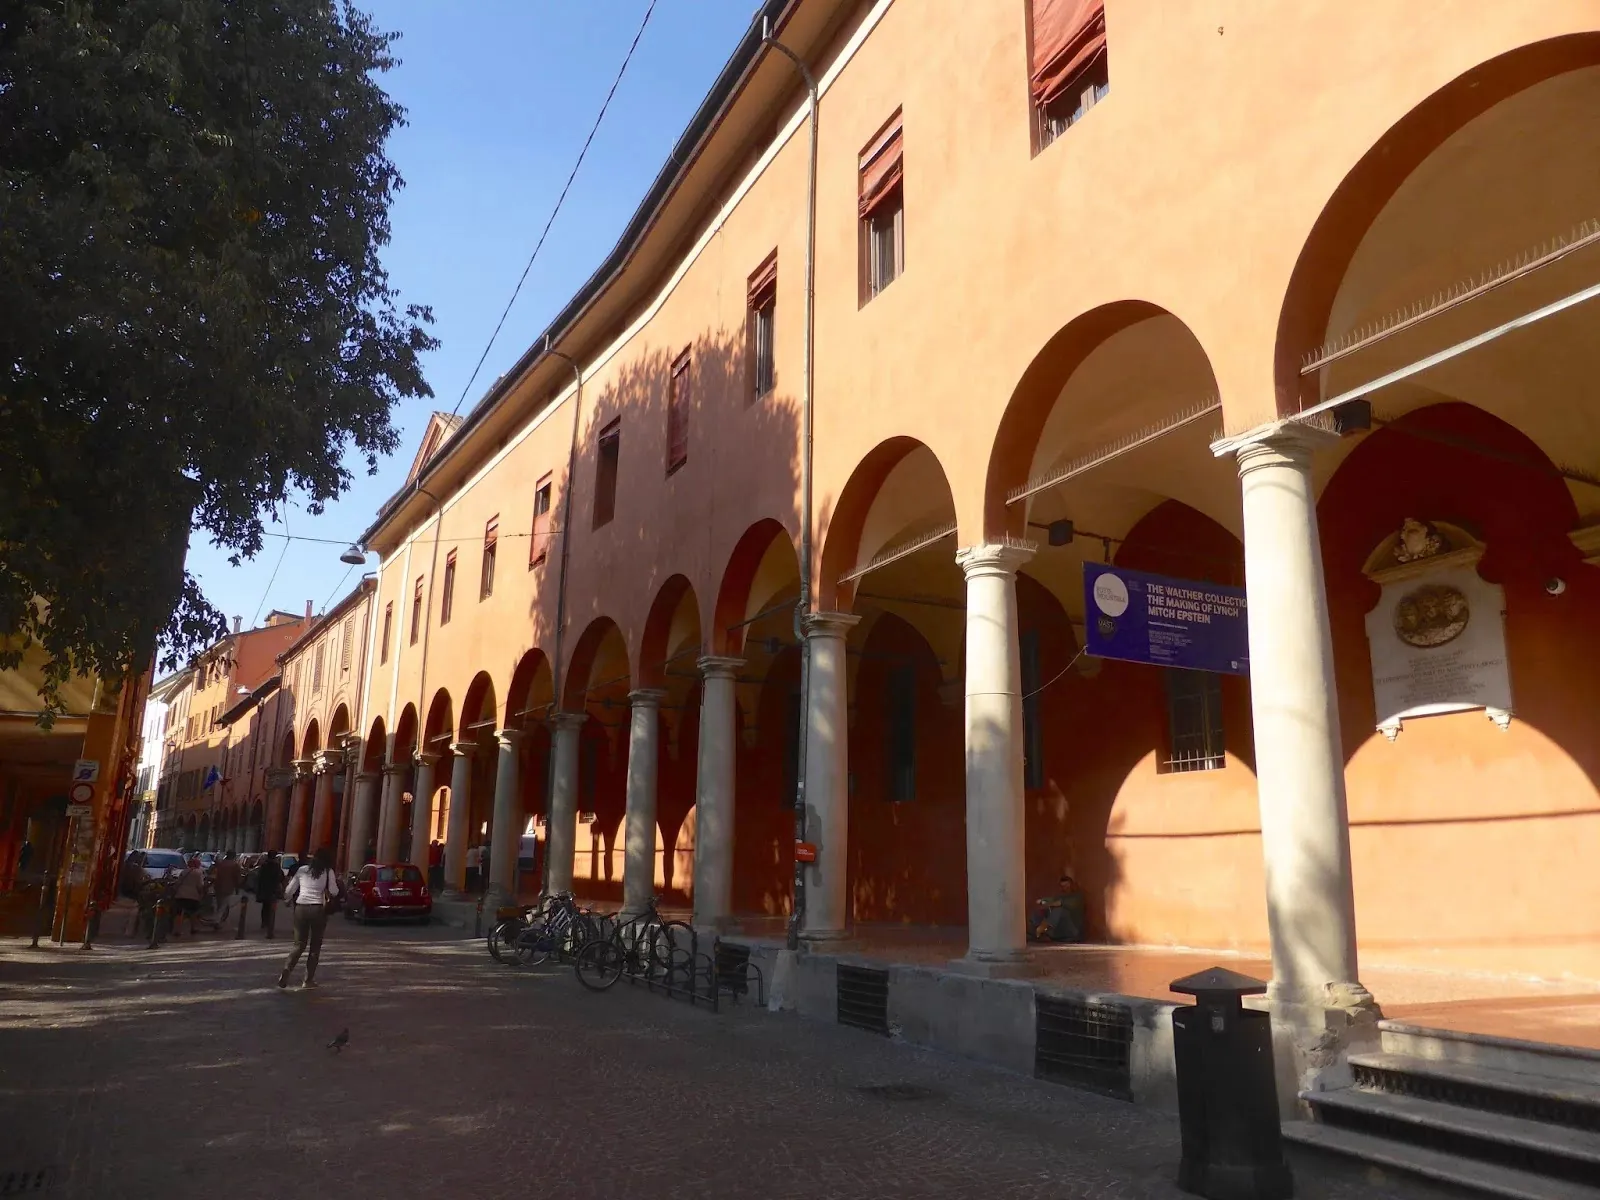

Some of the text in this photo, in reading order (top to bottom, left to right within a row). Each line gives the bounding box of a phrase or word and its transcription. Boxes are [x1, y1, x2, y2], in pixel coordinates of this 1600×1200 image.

[1147, 583, 1164, 594] THE
[1165, 586, 1203, 600] WALTHER
[1205, 593, 1248, 608] COLLECTIO
[1147, 594, 1239, 617] THE MAKING OF LYNCH
[1148, 606, 1210, 624] MITCH EPSTEIN
